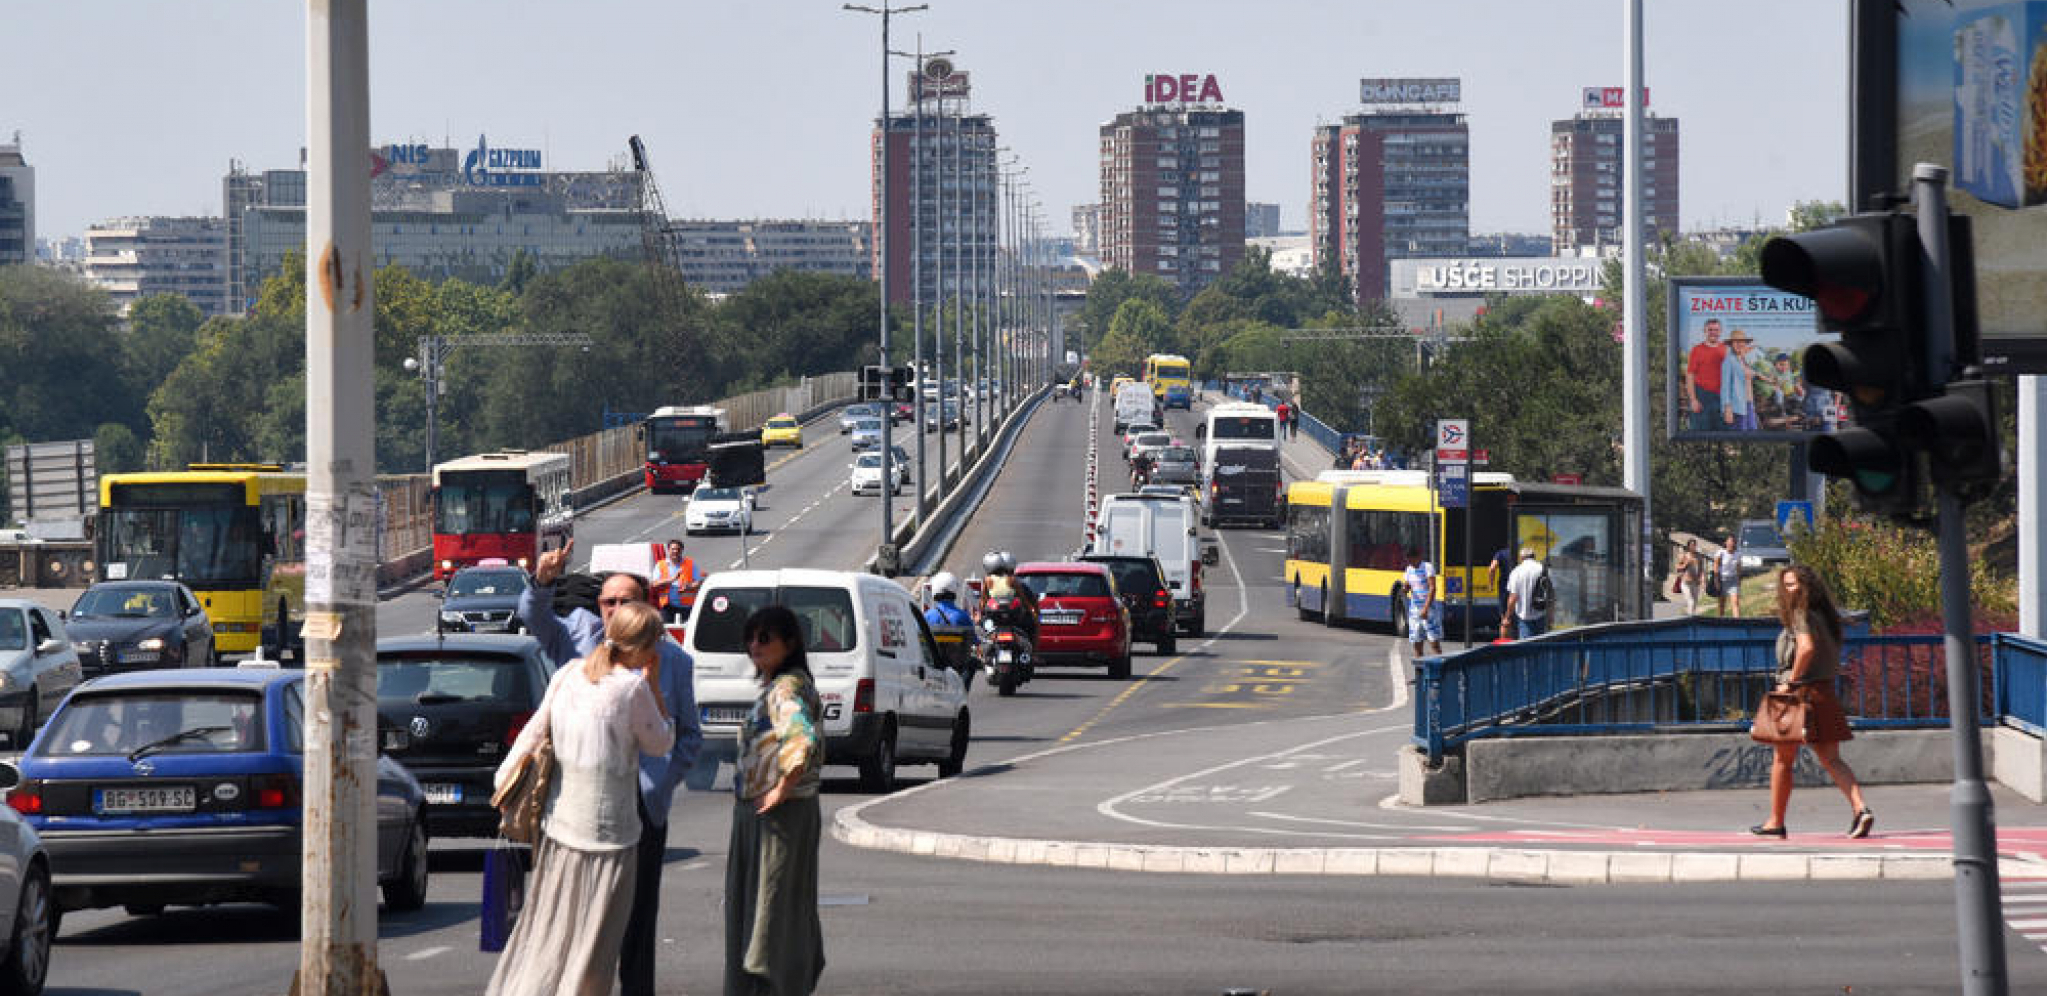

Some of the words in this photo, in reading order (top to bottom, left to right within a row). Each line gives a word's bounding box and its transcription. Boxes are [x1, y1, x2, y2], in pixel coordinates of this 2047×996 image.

[391, 144, 428, 163] NIS
[1691, 297, 1744, 311] ZNATE
[1748, 293, 1779, 311] ŠTA
